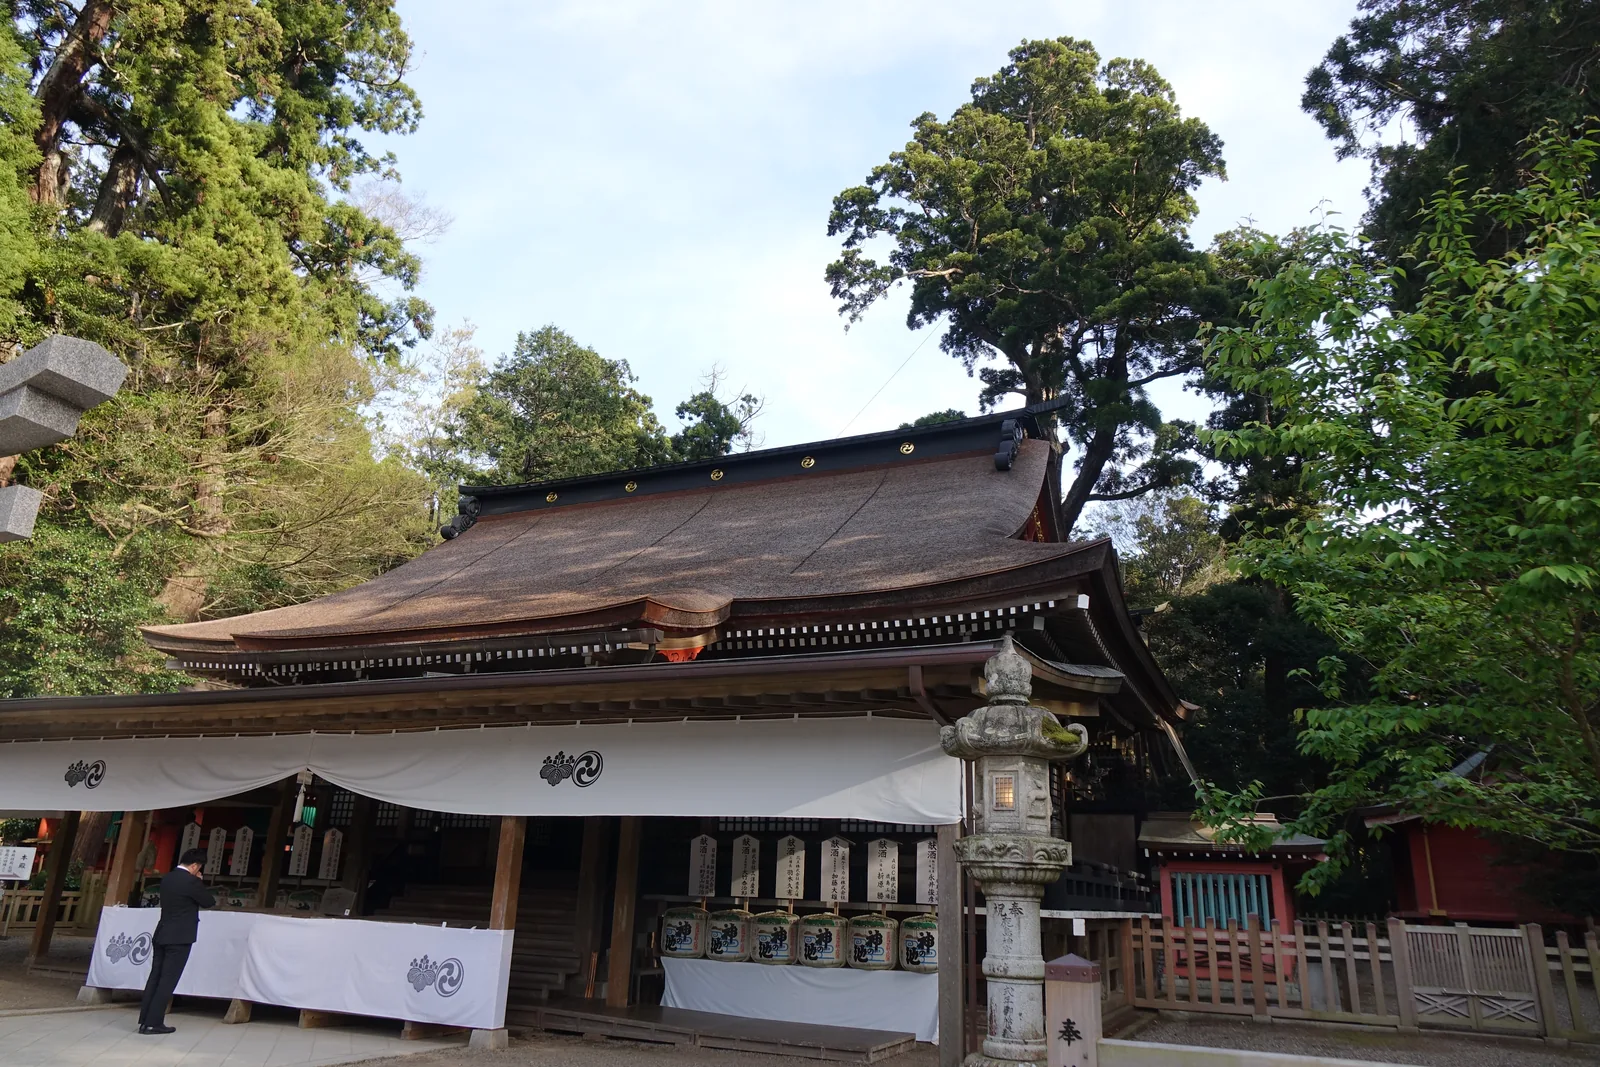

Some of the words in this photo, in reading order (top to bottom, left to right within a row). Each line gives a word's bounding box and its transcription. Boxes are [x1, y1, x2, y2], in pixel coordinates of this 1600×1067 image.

[699, 837, 709, 854] 献酒
[741, 837, 751, 855] 献酒
[786, 838, 796, 856] 献酒
[830, 839, 840, 857] 献酒
[878, 840, 888, 858] 献酒
[927, 840, 937, 859] 献酒
[18, 854, 28, 869] 本殿
